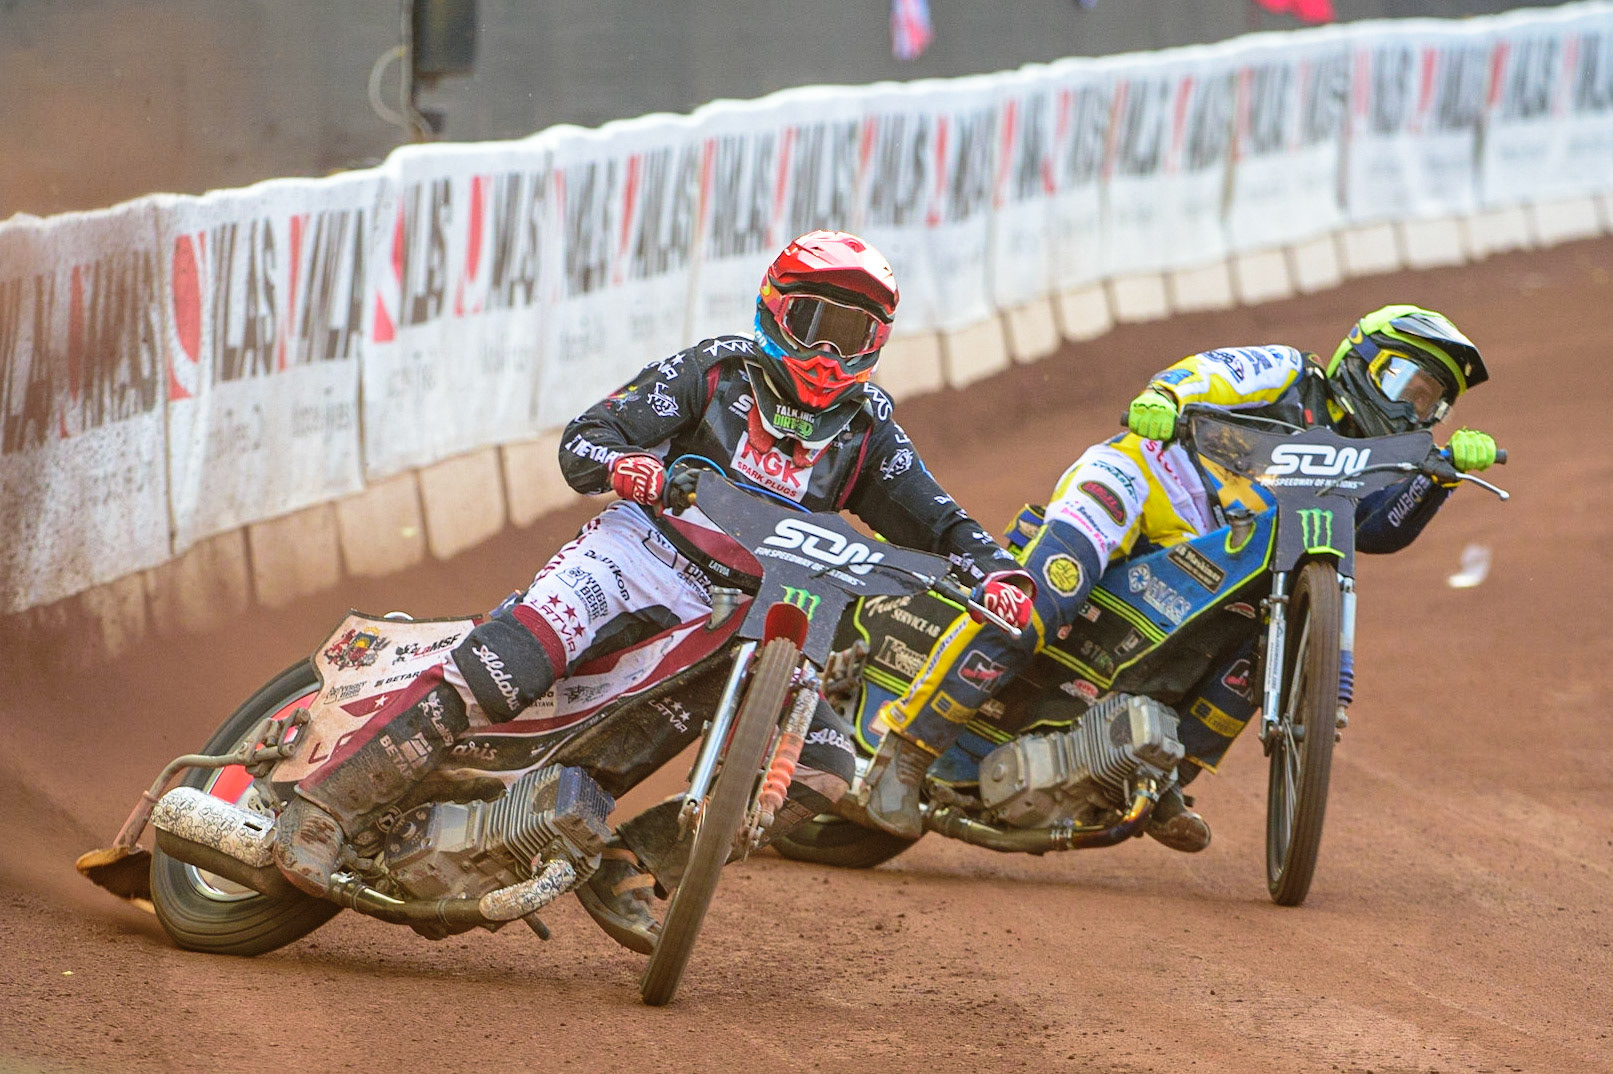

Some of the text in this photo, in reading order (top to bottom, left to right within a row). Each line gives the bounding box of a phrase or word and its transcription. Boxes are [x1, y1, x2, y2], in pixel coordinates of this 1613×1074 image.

[737, 461, 798, 498] SPARK PLUGS
[740, 440, 805, 488] NGK
[1275, 478, 1314, 487] SPEEDWAY
[1314, 478, 1325, 487] OF
[708, 560, 730, 578] LATVIA
[769, 549, 814, 568] SPEEDWAY
[580, 585, 600, 621] BEAR
[529, 600, 577, 652] LATVIA
[891, 608, 941, 638] SERVICE AB
